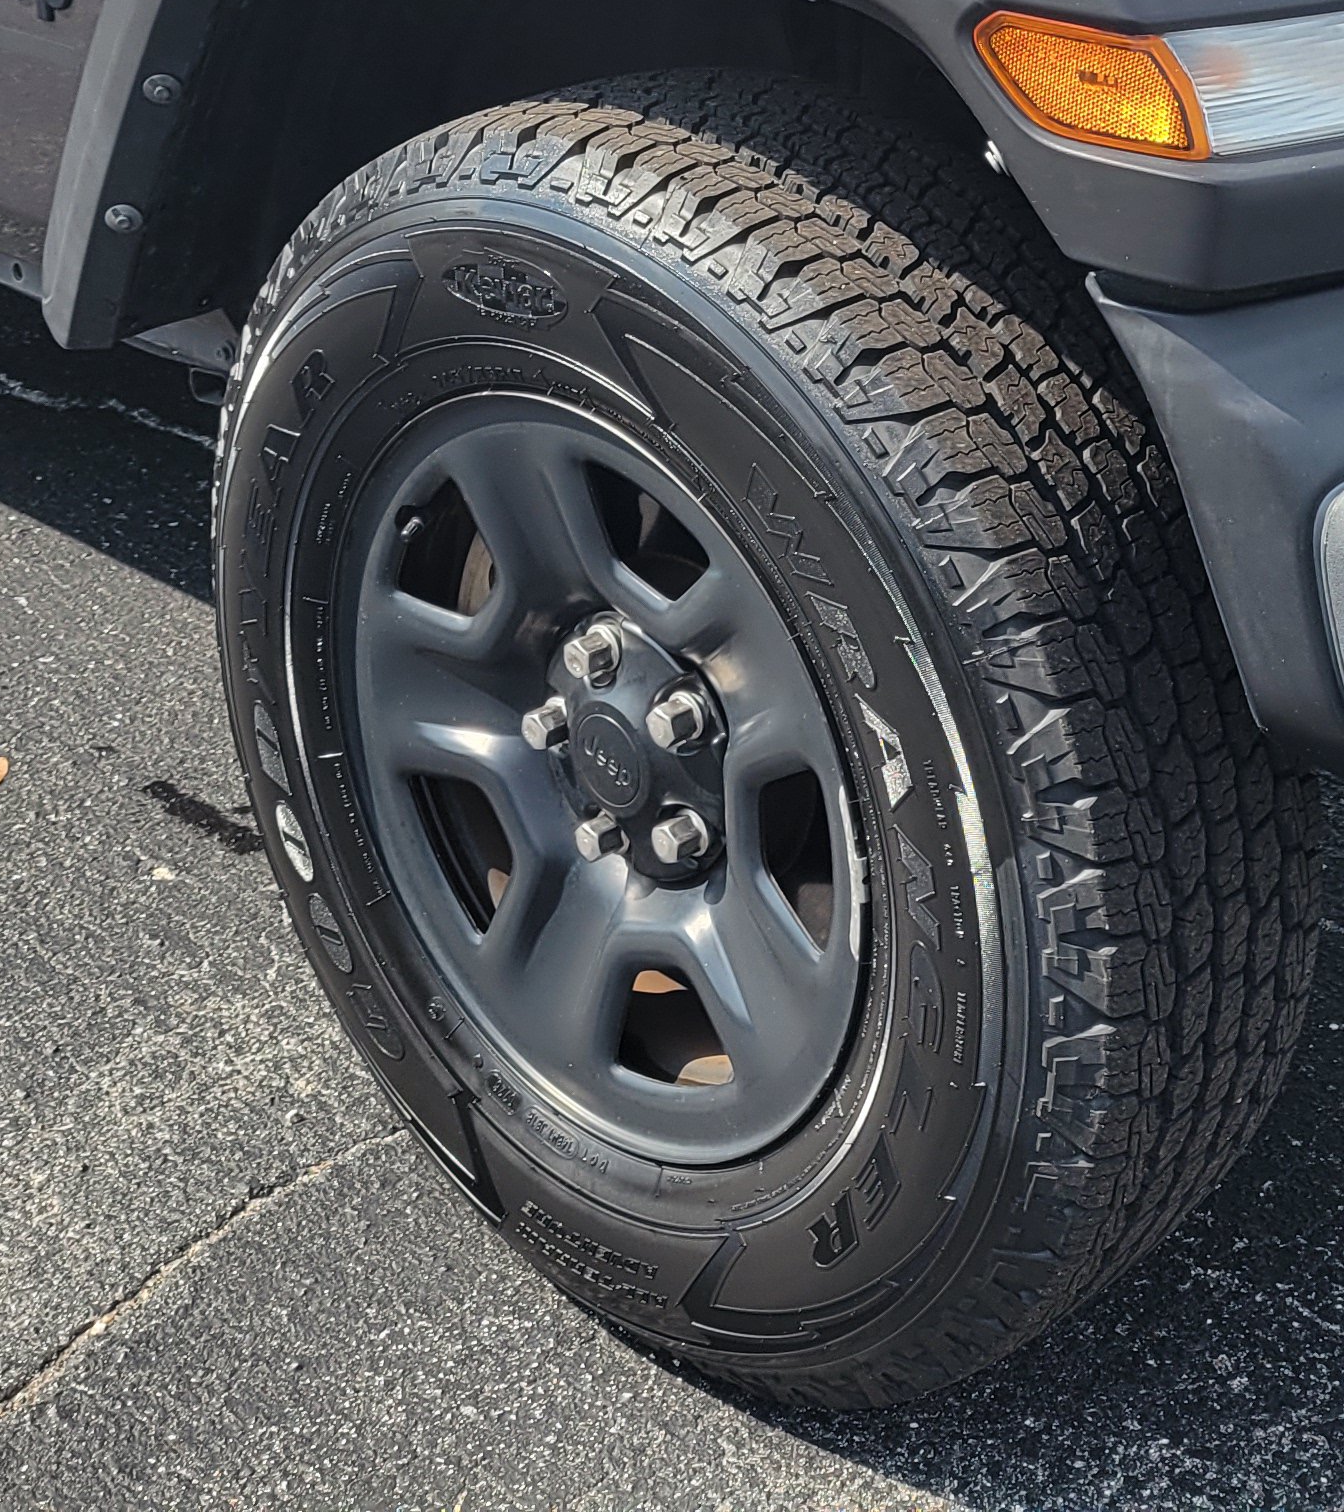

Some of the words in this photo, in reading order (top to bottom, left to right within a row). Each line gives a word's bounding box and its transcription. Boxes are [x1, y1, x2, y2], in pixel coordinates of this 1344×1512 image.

[582, 734, 631, 787] Jeep
[742, 462, 945, 1269] WRANGLER
[520, 1199, 660, 1280] ADVENTURE
